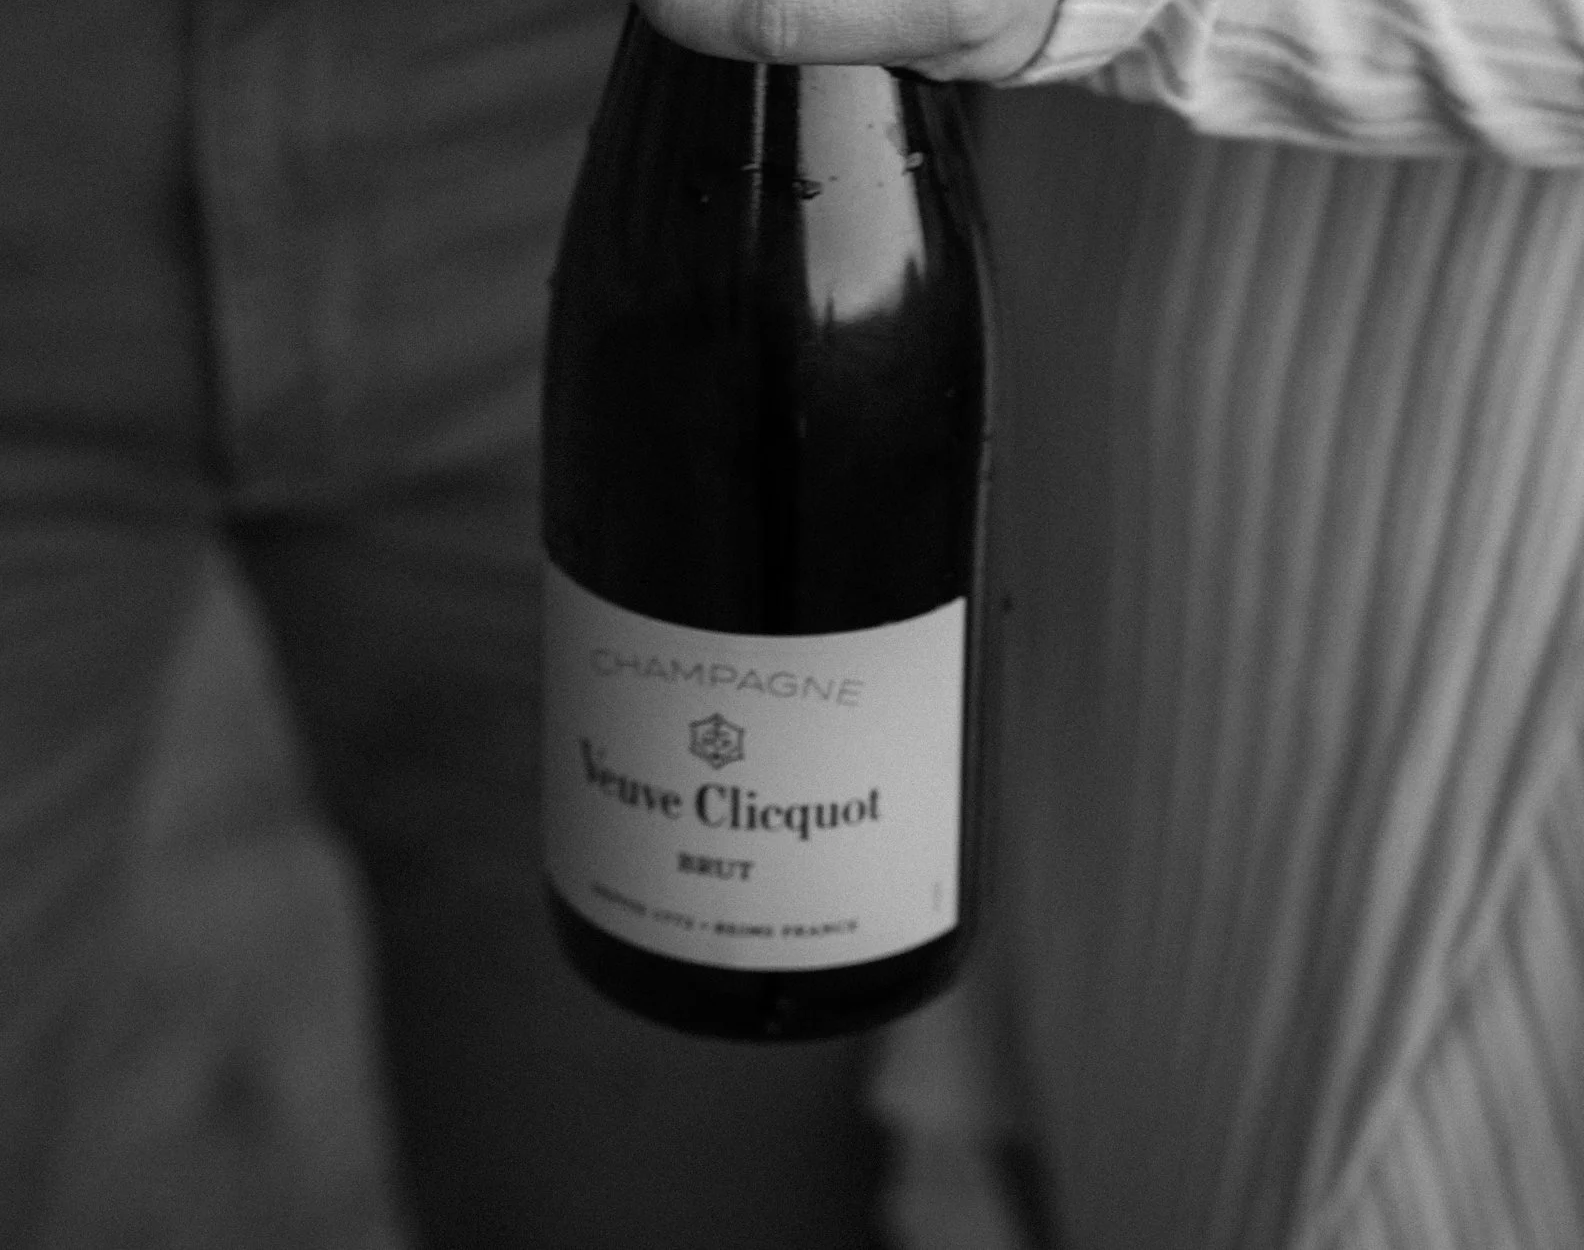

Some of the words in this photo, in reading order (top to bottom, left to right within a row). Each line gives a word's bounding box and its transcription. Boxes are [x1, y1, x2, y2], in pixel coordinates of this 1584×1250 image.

[592, 648, 865, 707] CHAMPAGNE
[694, 782, 881, 841] Clicquot
[678, 852, 755, 882] BRUT
